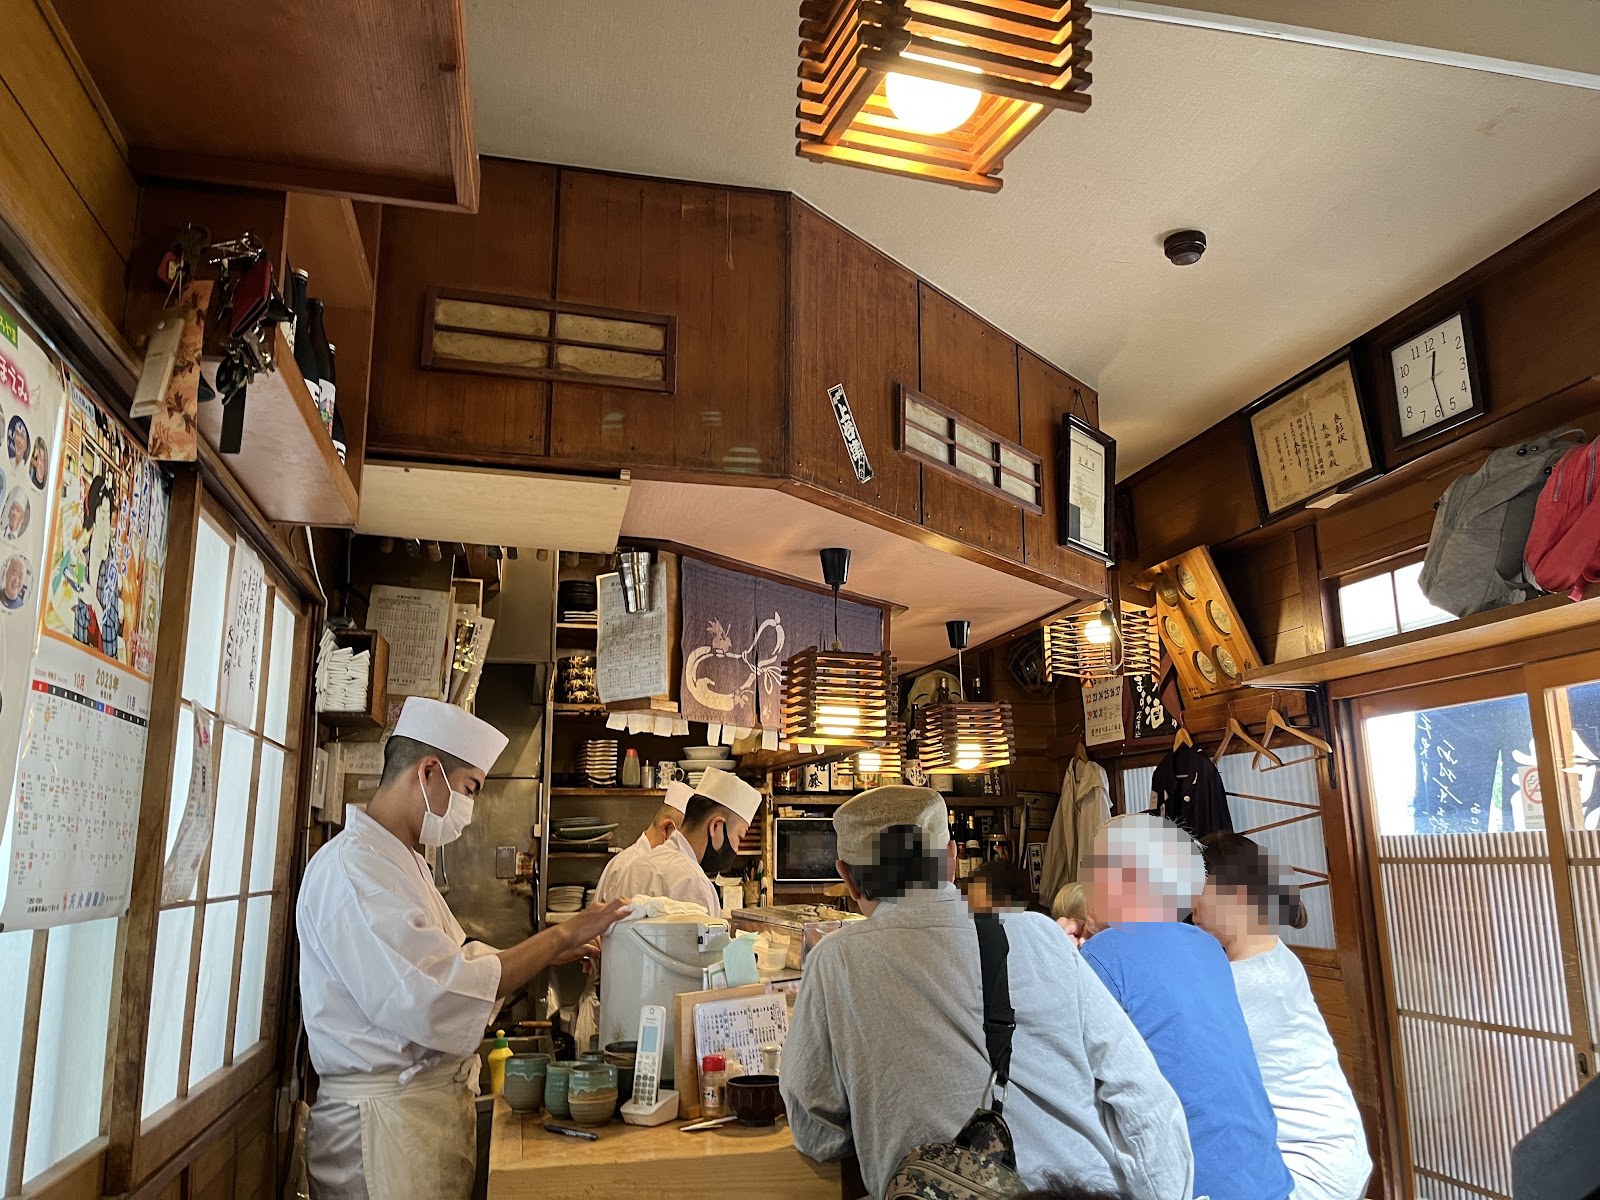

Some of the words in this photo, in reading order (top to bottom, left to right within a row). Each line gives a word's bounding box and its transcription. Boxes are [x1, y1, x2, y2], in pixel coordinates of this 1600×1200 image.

[1441, 331, 1446, 344] 1
[1454, 335, 1462, 349] 2
[1424, 337, 1434, 353] 12
[1411, 346, 1420, 360] 11
[1459, 356, 1466, 370] 3
[1400, 363, 1409, 378] 10
[1402, 385, 1409, 398] 9
[1461, 380, 1467, 392] 4
[1449, 396, 1456, 410] 5
[1406, 405, 1413, 419] 8
[1420, 410, 1426, 423] 7
[1434, 404, 1441, 418] 6
[1334, 413, 1347, 444] 表彰状
